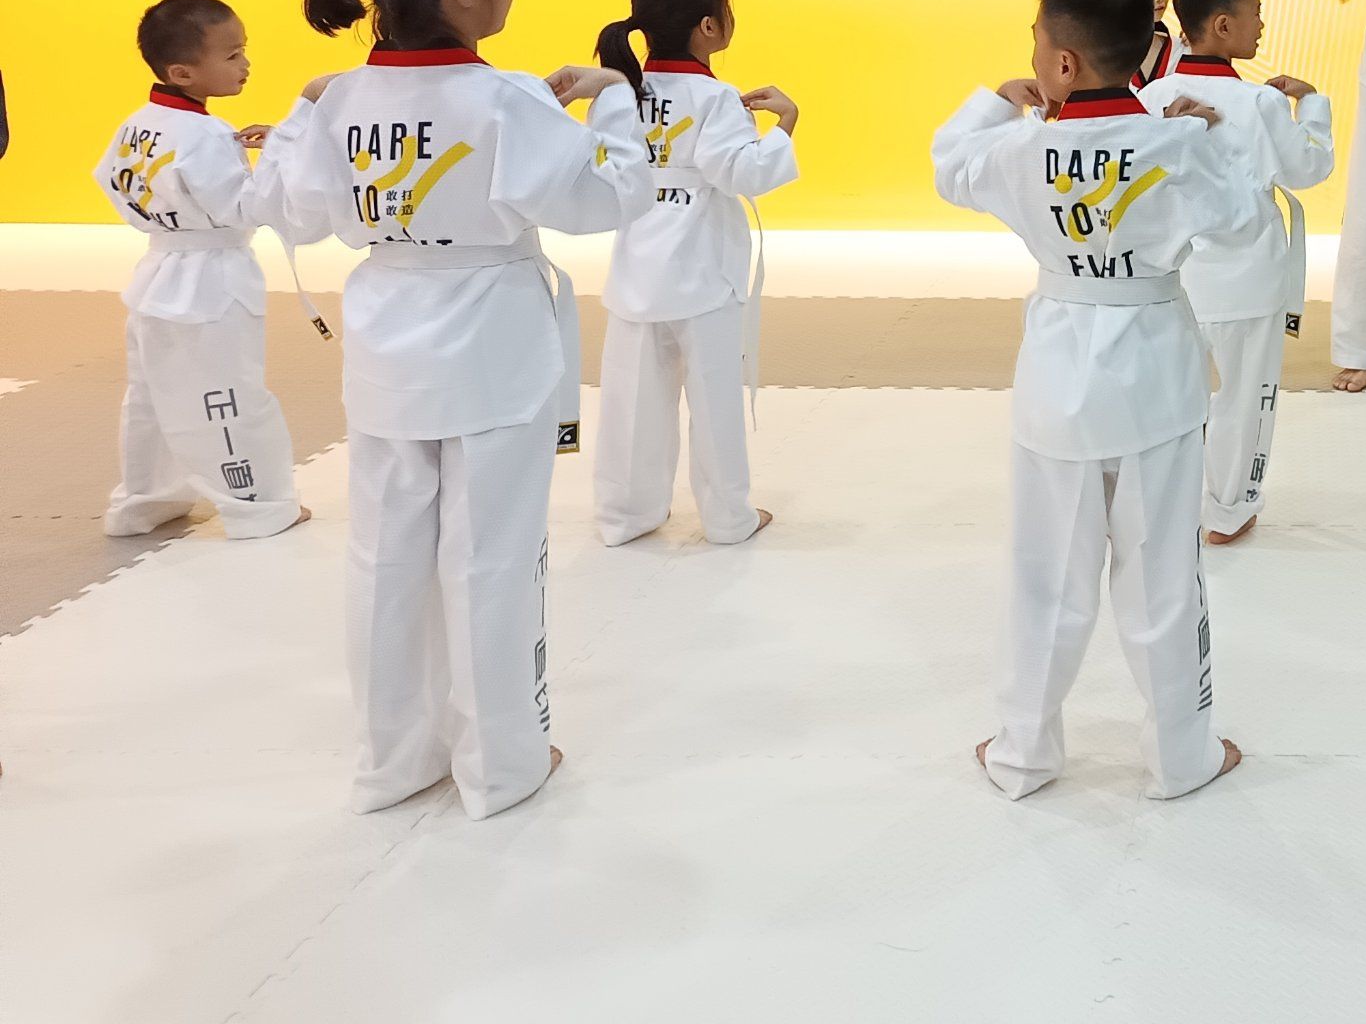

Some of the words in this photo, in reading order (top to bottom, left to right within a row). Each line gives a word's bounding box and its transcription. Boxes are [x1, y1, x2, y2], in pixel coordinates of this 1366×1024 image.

[348, 122, 432, 163] DARE
[1046, 149, 1135, 184] DARE
[353, 185, 381, 223] TO
[1050, 202, 1094, 237] TO
